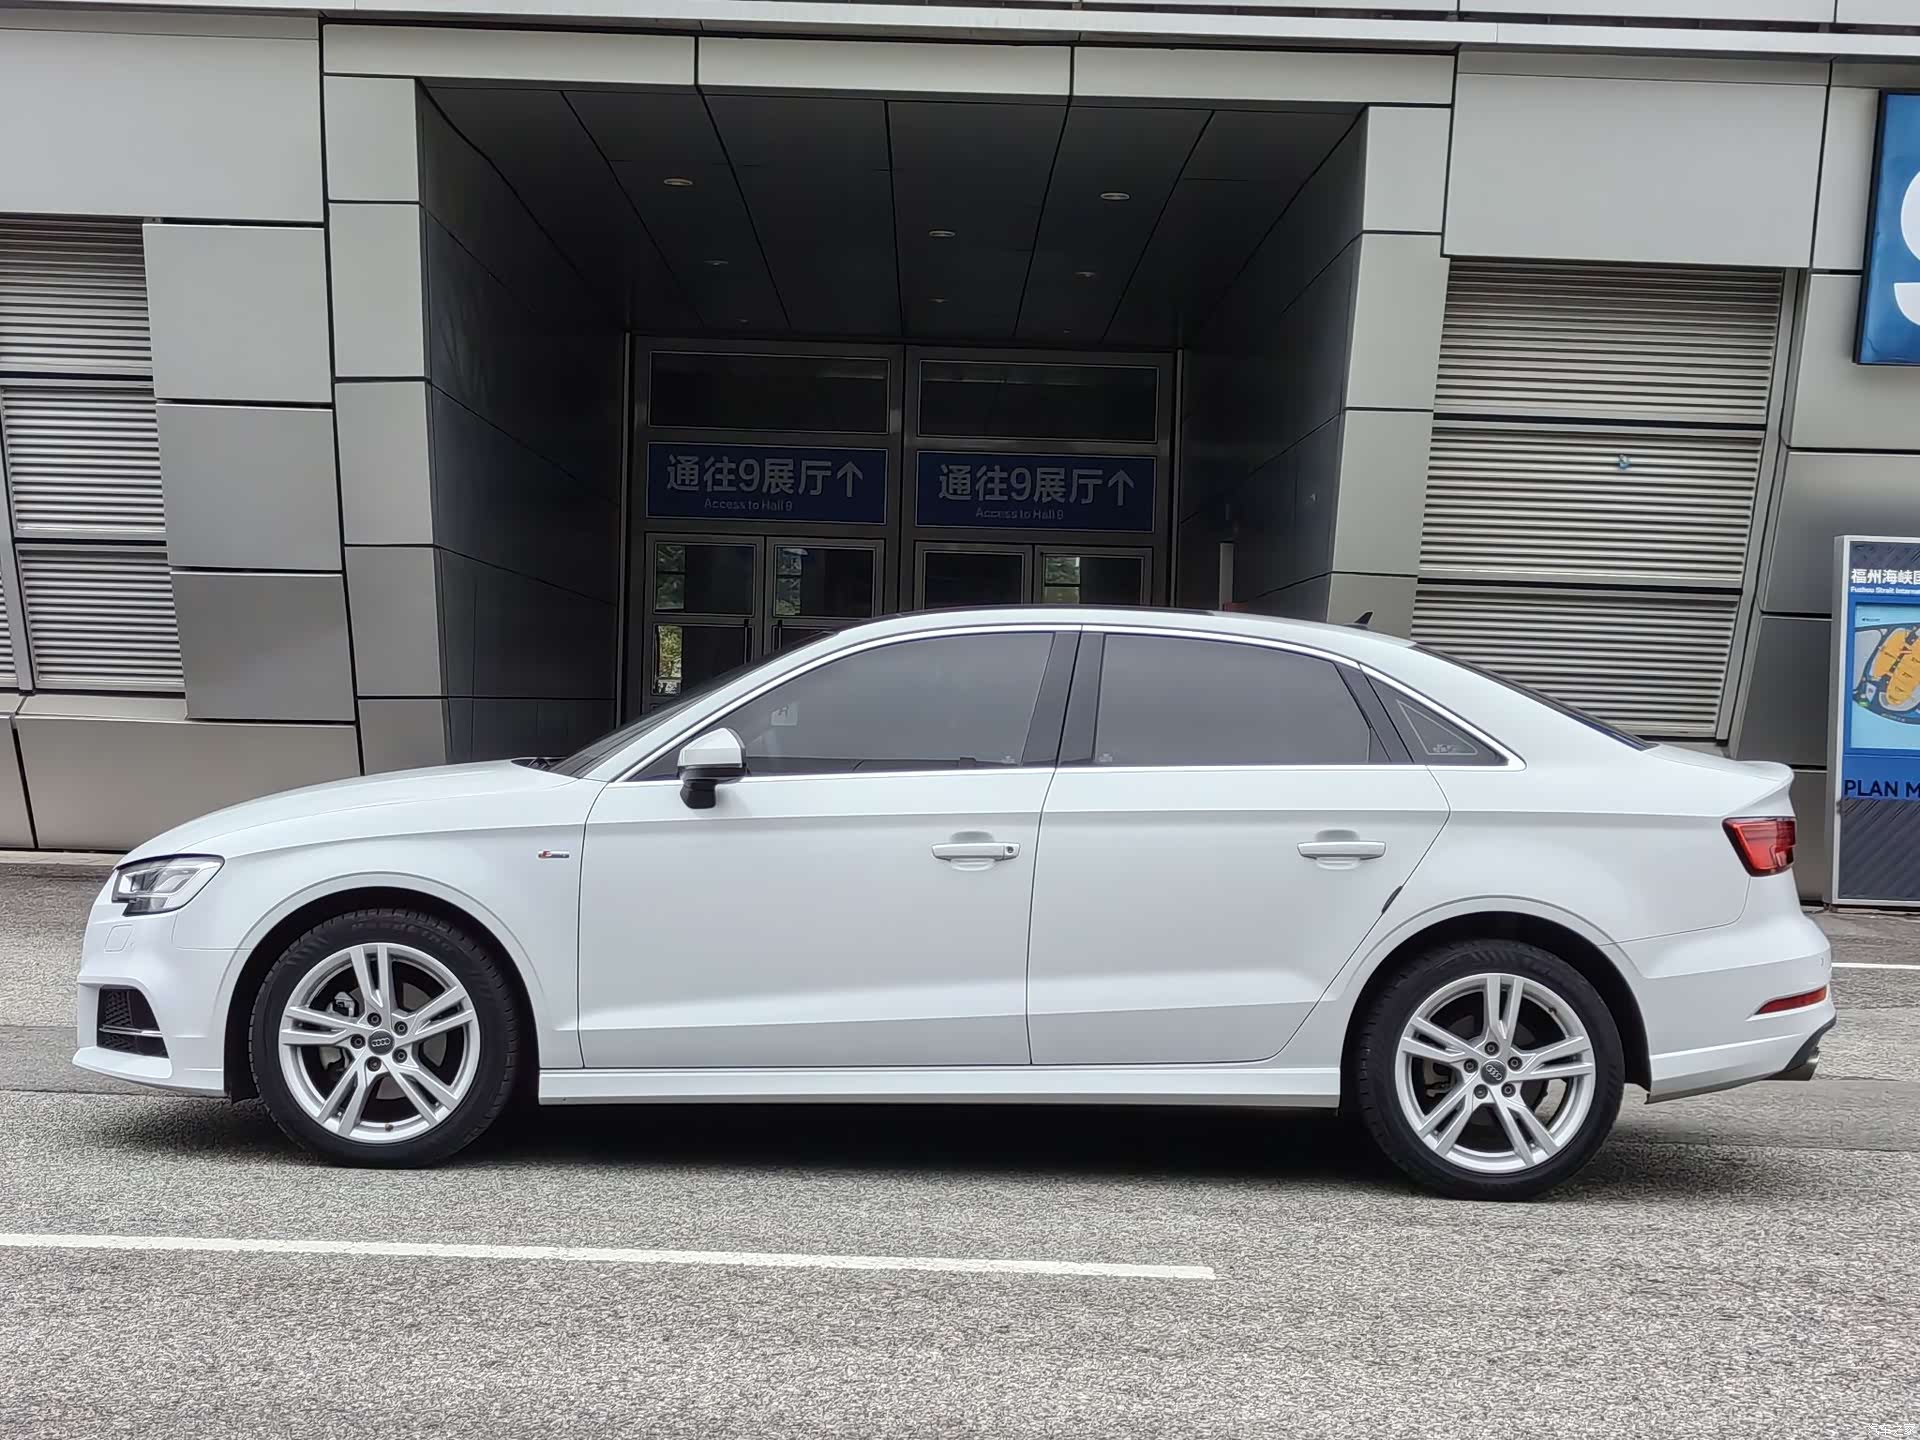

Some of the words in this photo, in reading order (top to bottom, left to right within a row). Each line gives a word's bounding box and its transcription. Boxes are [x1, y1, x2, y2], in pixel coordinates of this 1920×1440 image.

[666, 454, 833, 496] 通往9展厅
[938, 464, 1104, 504] 通往9展厅
[704, 498, 746, 510] Access
[748, 500, 760, 511] to
[761, 499, 784, 511] Hall
[975, 507, 1018, 519] Access
[1033, 509, 1055, 520] Hall
[1844, 779, 1898, 798] PLAN
